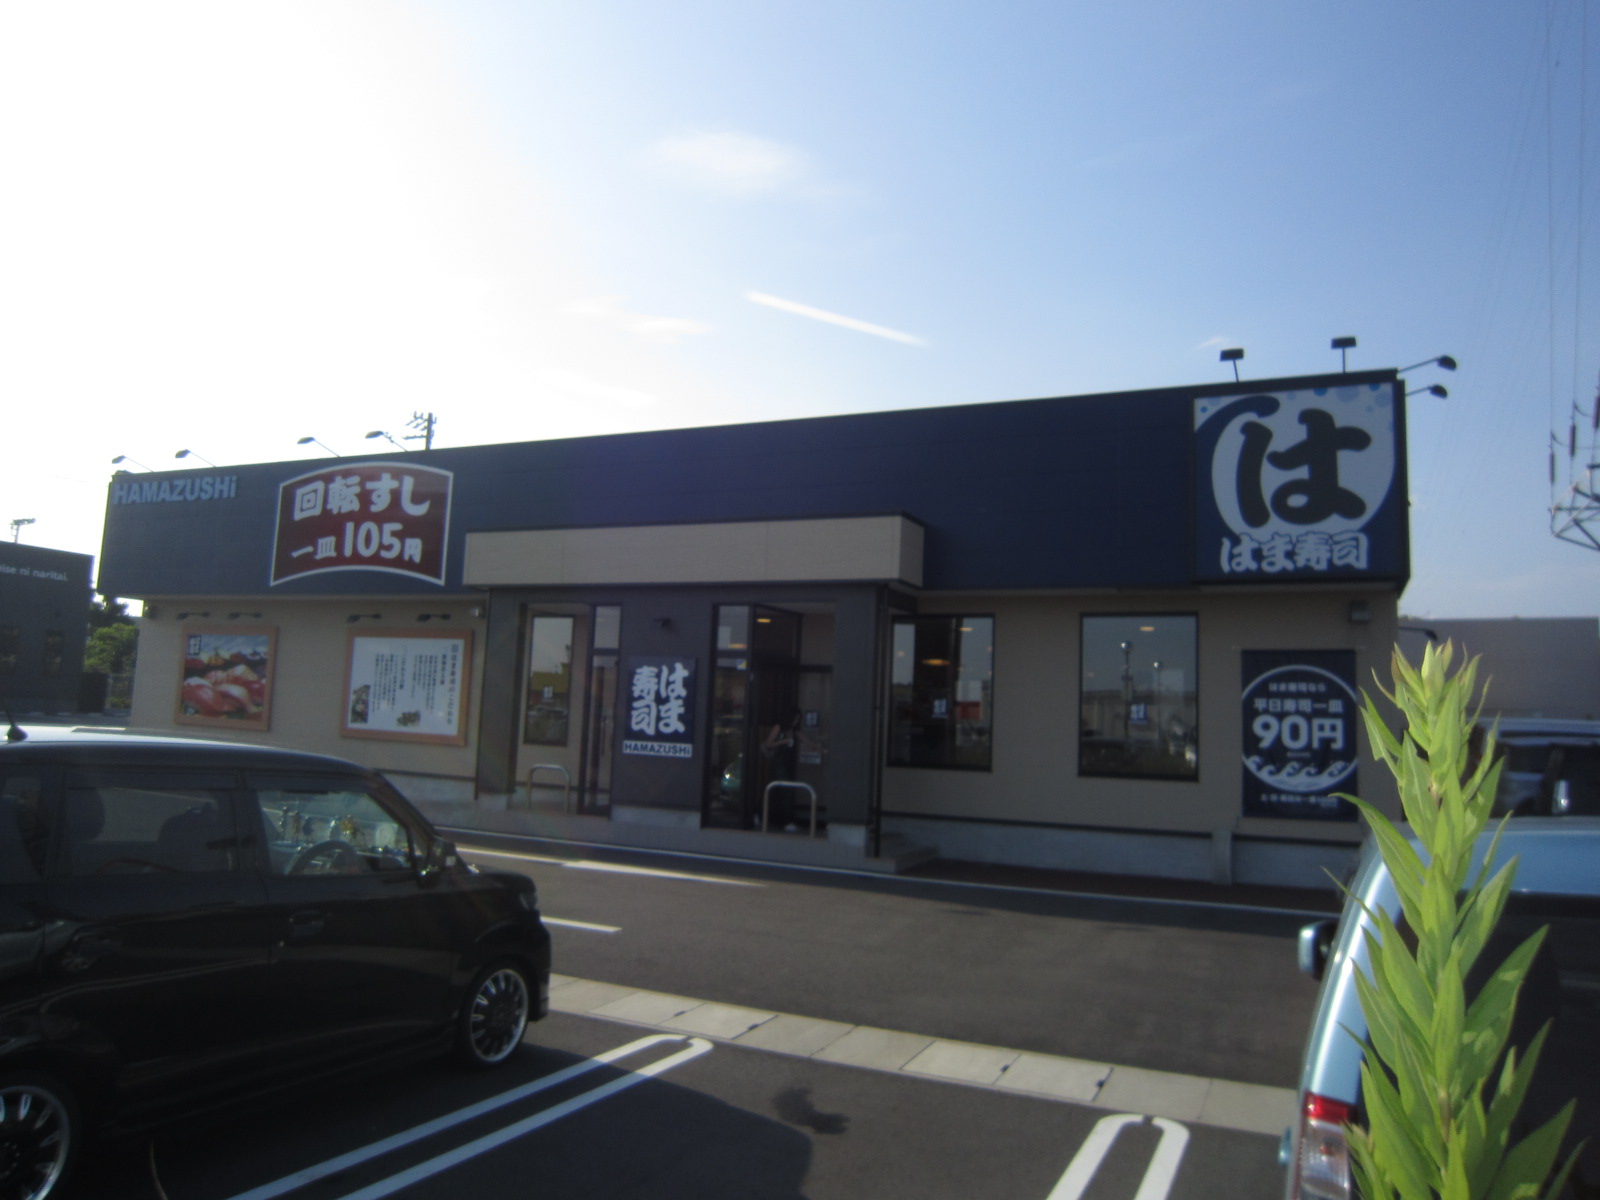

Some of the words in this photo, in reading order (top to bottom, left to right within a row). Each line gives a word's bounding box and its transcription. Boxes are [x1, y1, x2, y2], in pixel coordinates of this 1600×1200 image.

[293, 472, 431, 521] 回転すし
[1235, 408, 1372, 528] は
[1220, 530, 1369, 573] はま寿司
[631, 665, 658, 736] 寿司
[658, 662, 689, 734] はま
[1252, 714, 1344, 750] 90円
